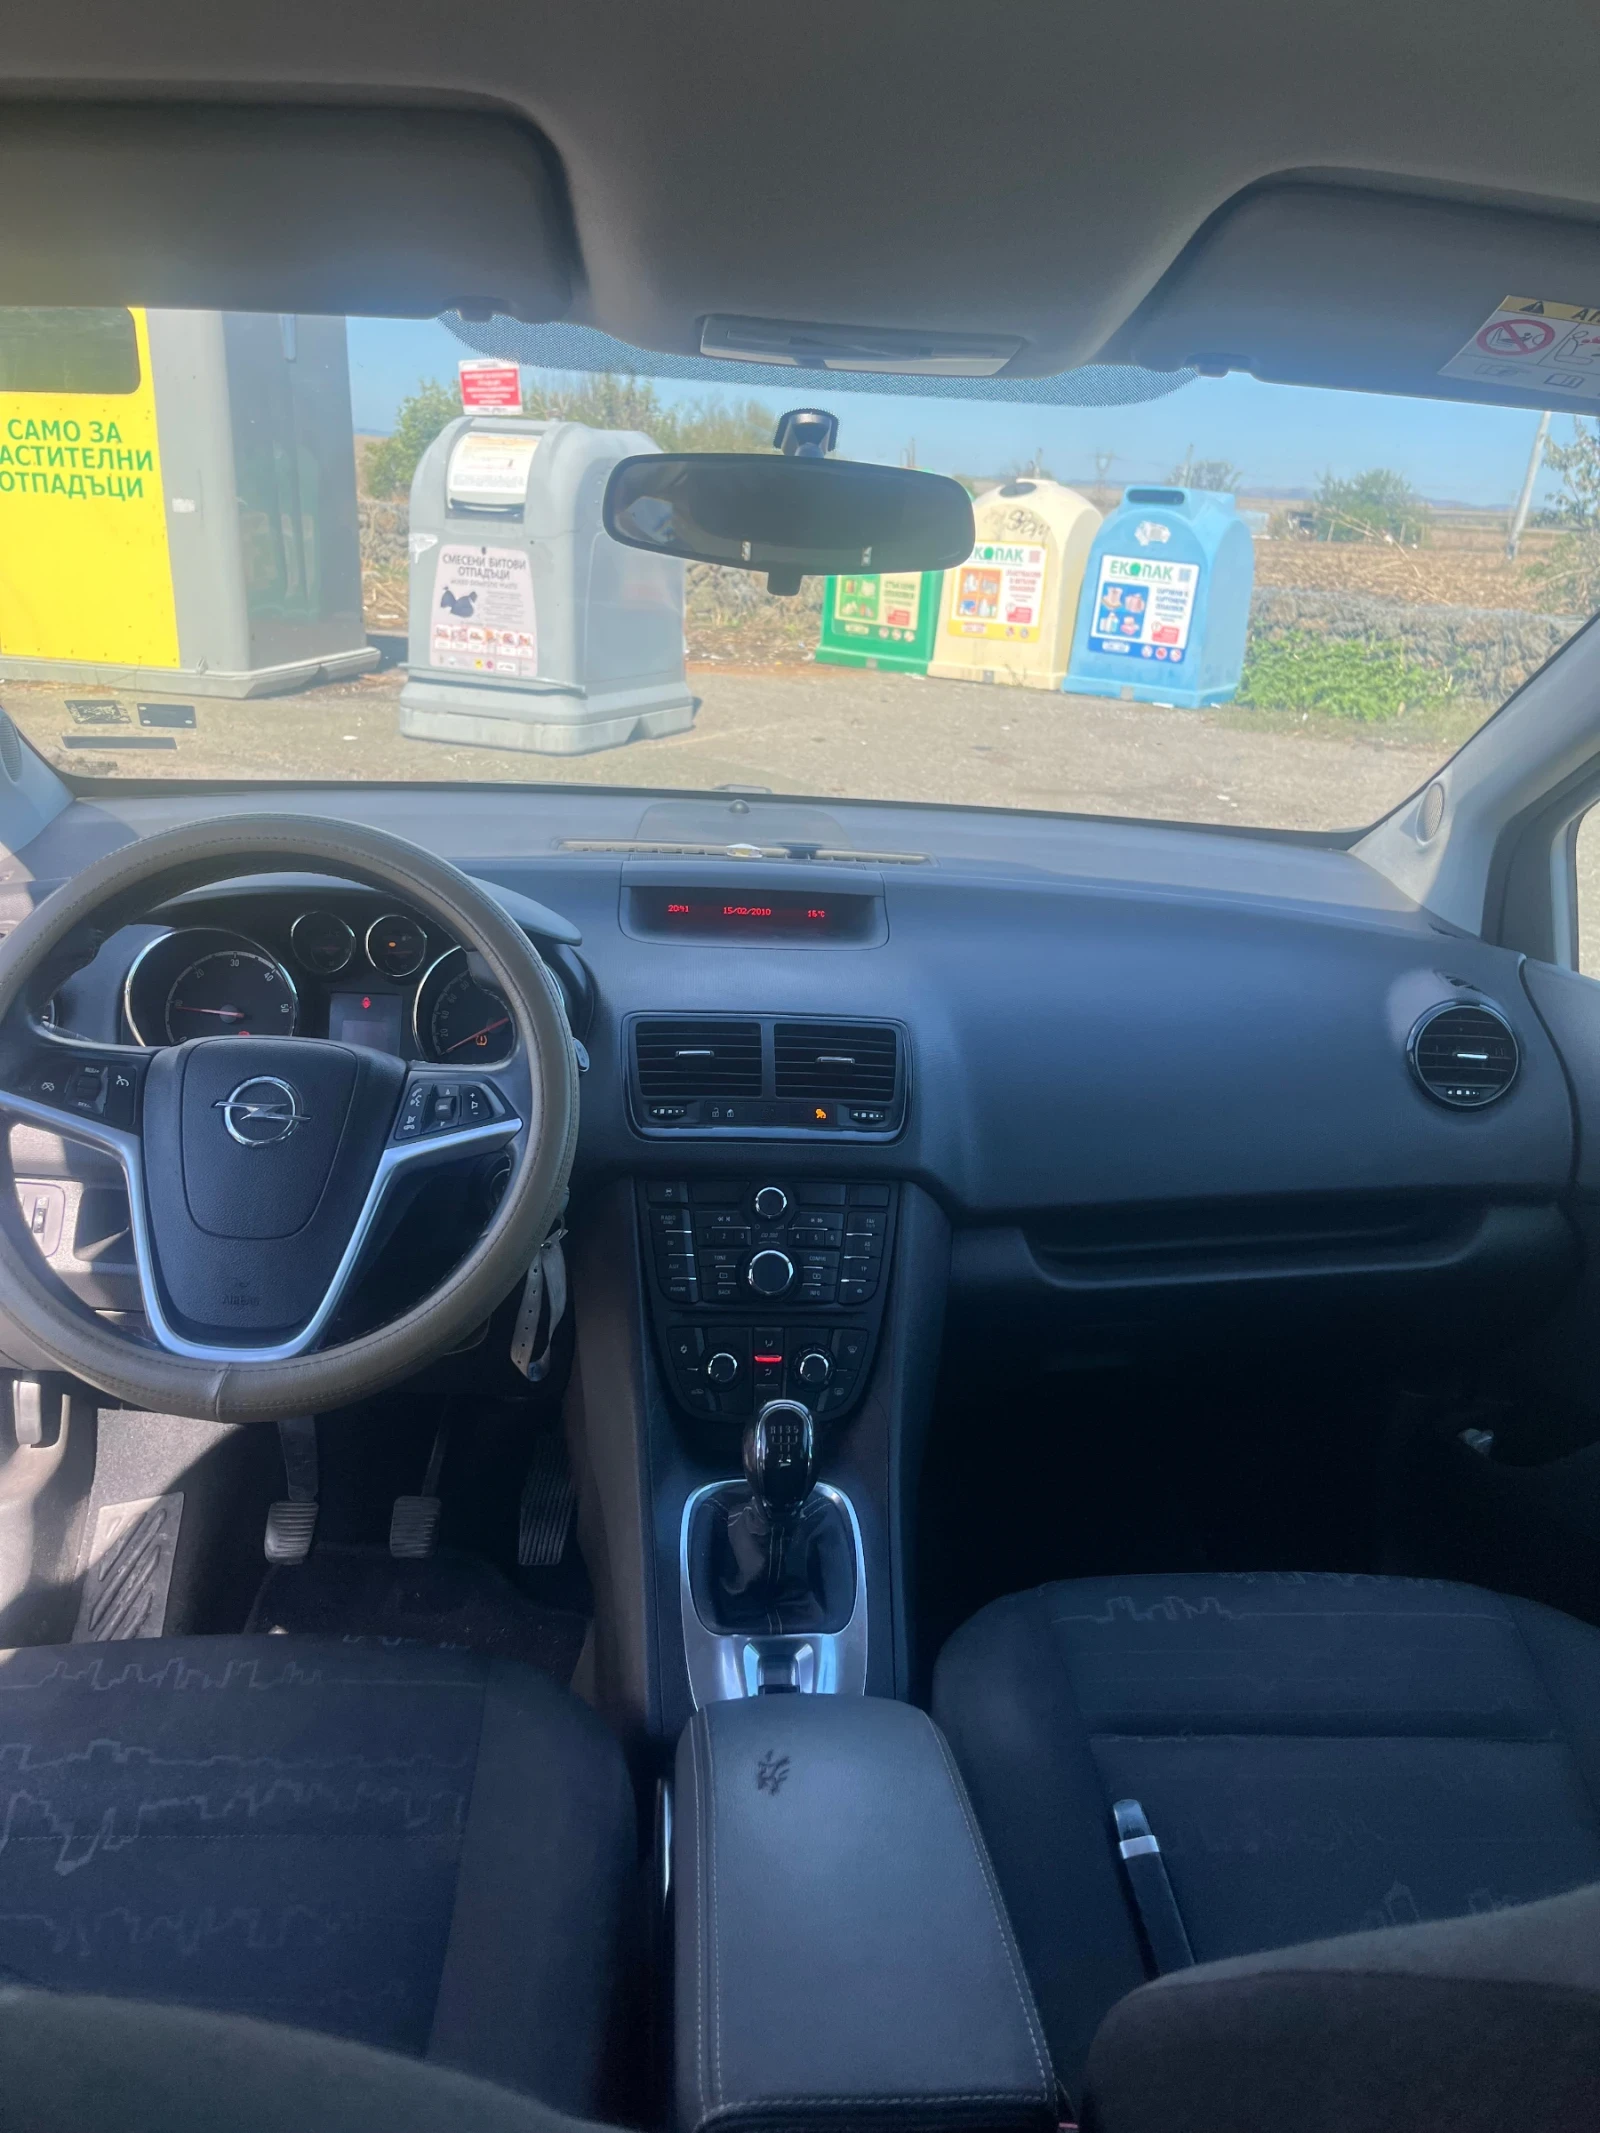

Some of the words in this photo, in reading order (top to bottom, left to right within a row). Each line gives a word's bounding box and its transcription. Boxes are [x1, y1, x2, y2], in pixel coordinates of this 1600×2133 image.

[7, 418, 81, 442] САМО
[88, 420, 122, 444] ЗА
[0, 470, 143, 502] ОТПАДЪЦИ
[442, 553, 486, 566] СМЕСЕНИ
[489, 557, 527, 570] БИТОВИ
[458, 565, 511, 580] ОТПАДЪЦИ
[723, 906, 772, 916] 15/02/2010
[229, 958, 239, 967] 30
[263, 971, 274, 982] 40
[279, 1003, 290, 1013] 50
[440, 1028, 449, 1038] 20
[721, 1232, 727, 1240] 2
[740, 1232, 746, 1240] 3
[785, 1425, 791, 1434] 3
[793, 1425, 799, 1434] 5
